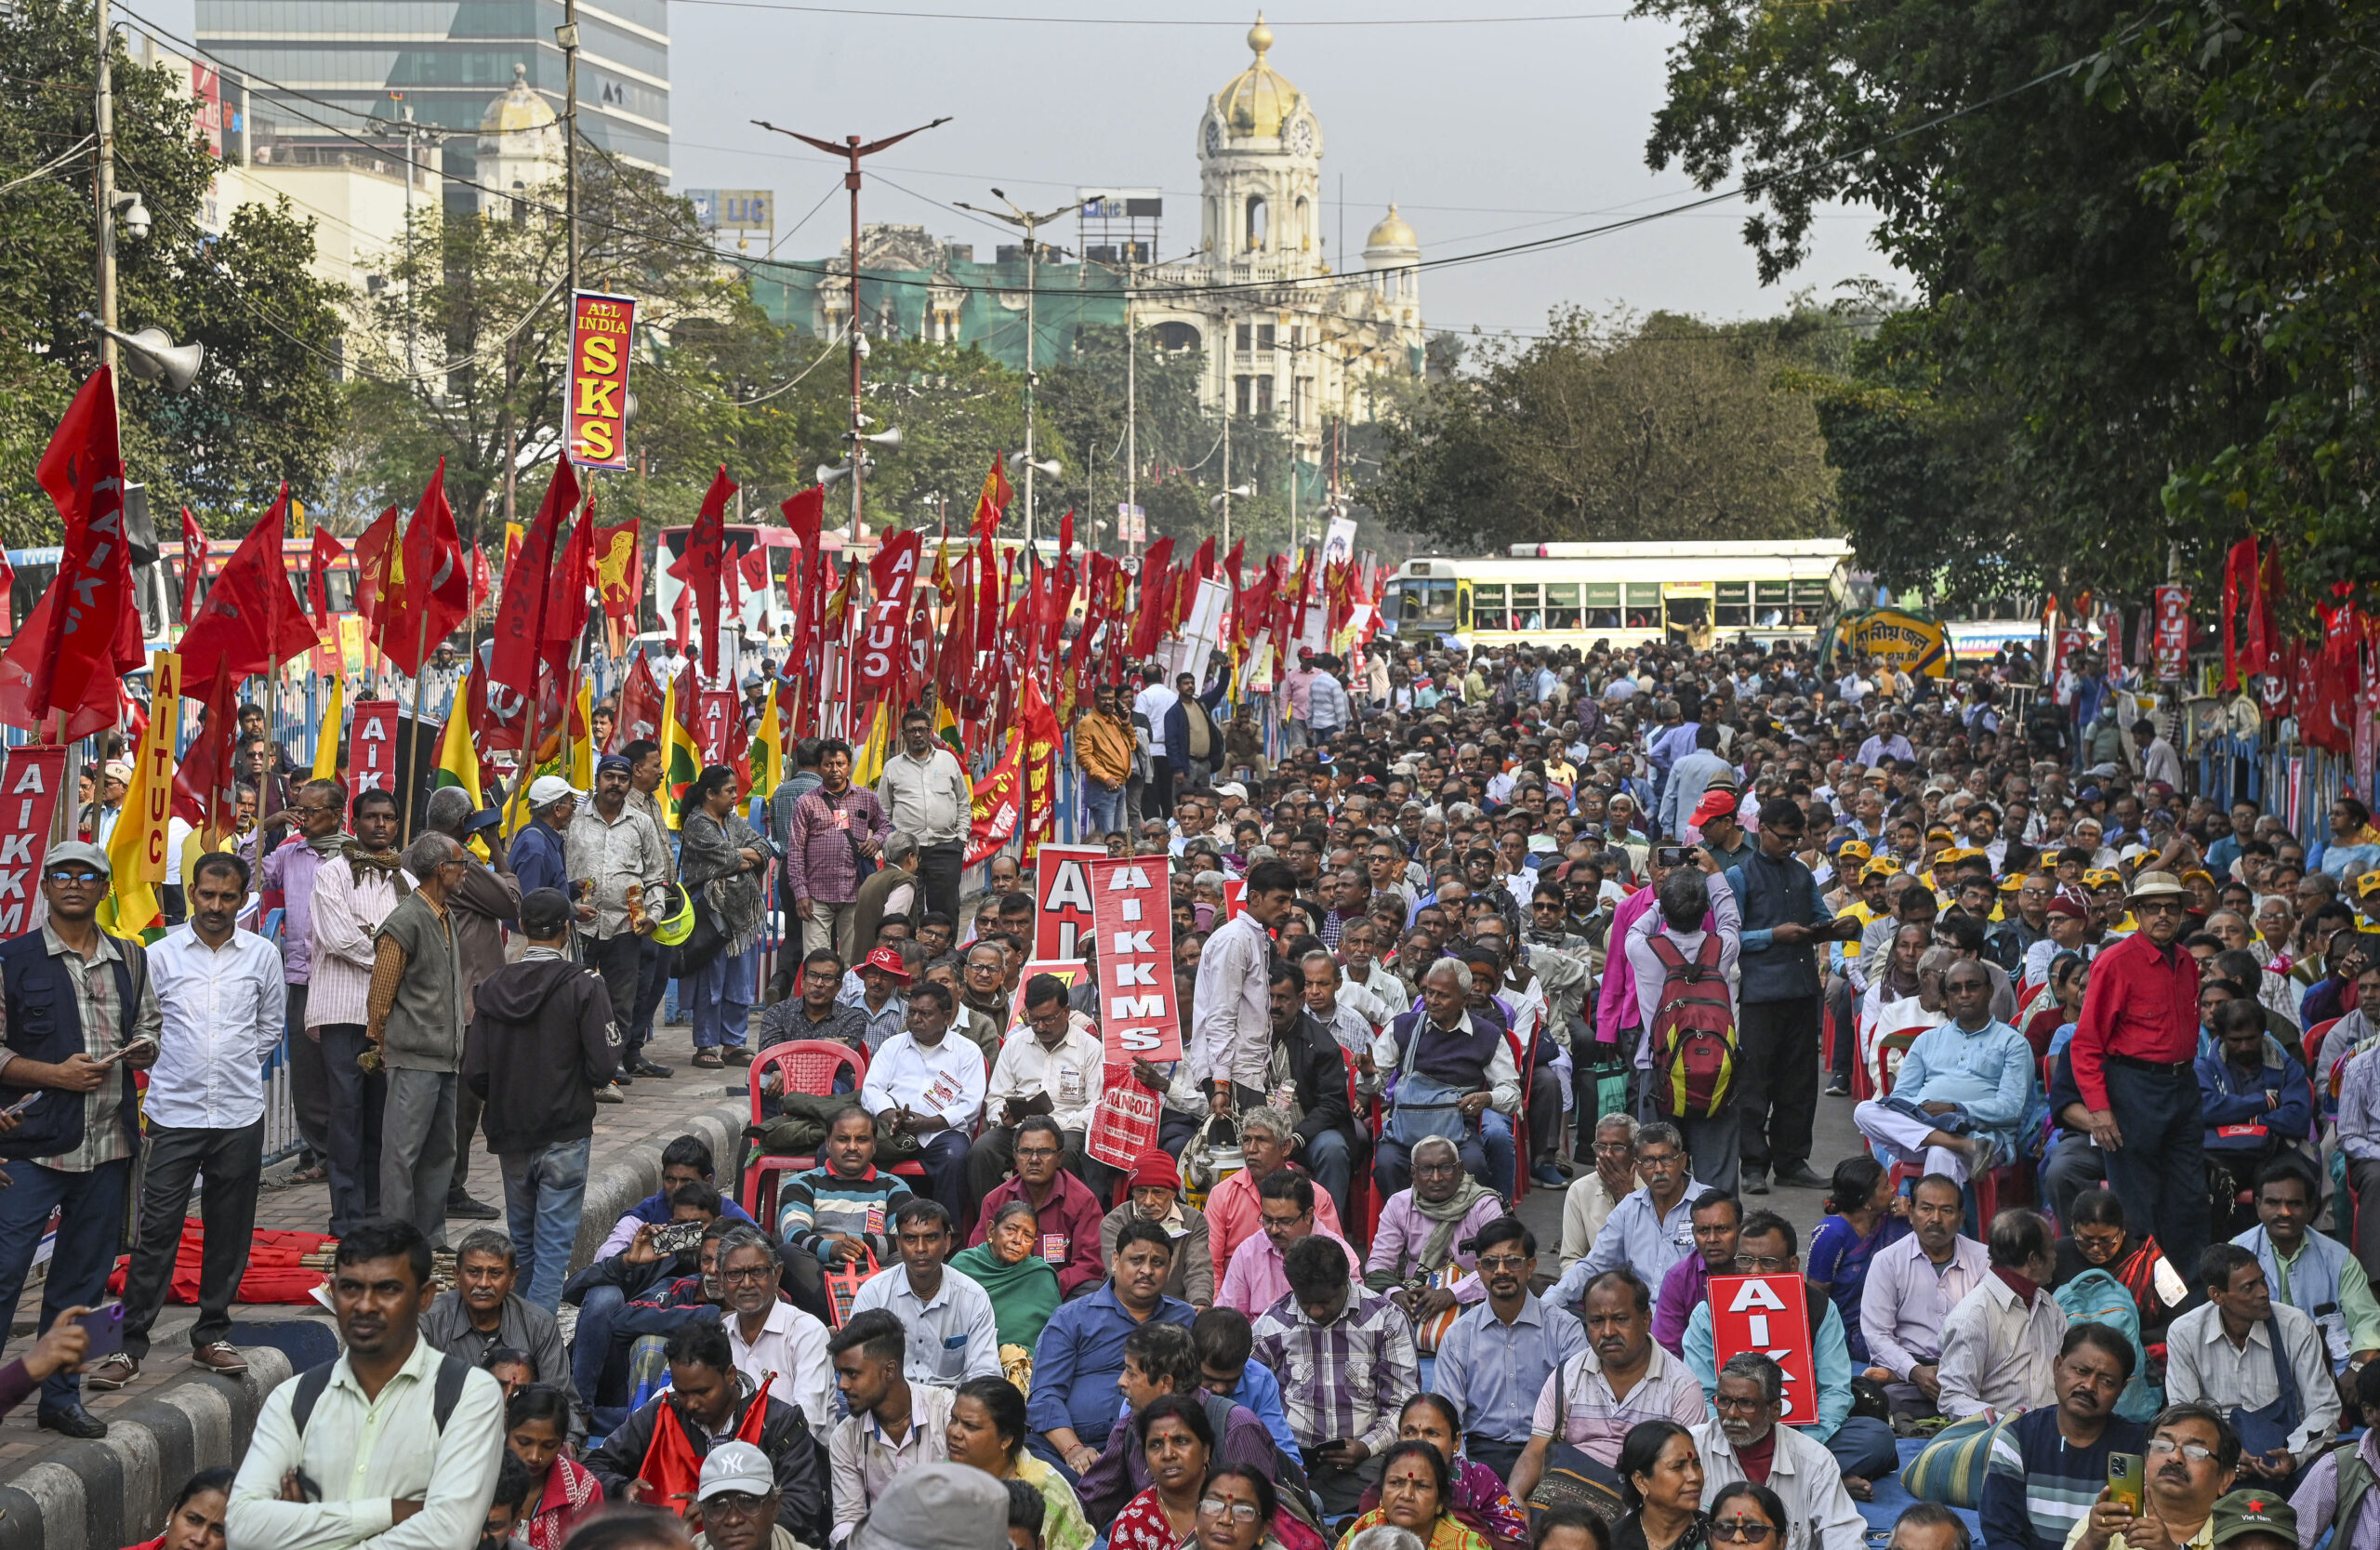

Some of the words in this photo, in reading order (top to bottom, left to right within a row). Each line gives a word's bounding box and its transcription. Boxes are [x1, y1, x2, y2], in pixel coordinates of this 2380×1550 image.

[729, 198, 764, 222] LIC
[587, 302, 622, 318] ALL
[577, 316, 628, 335] INDIA
[704, 700, 722, 769] AIK
[149, 664, 174, 865] AITUC
[1107, 866, 1167, 1054] AIKKMS
[1105, 1091, 1155, 1119] RANGOLI
[2241, 1514, 2256, 1522] Viet
[2256, 1514, 2272, 1523] Nam
